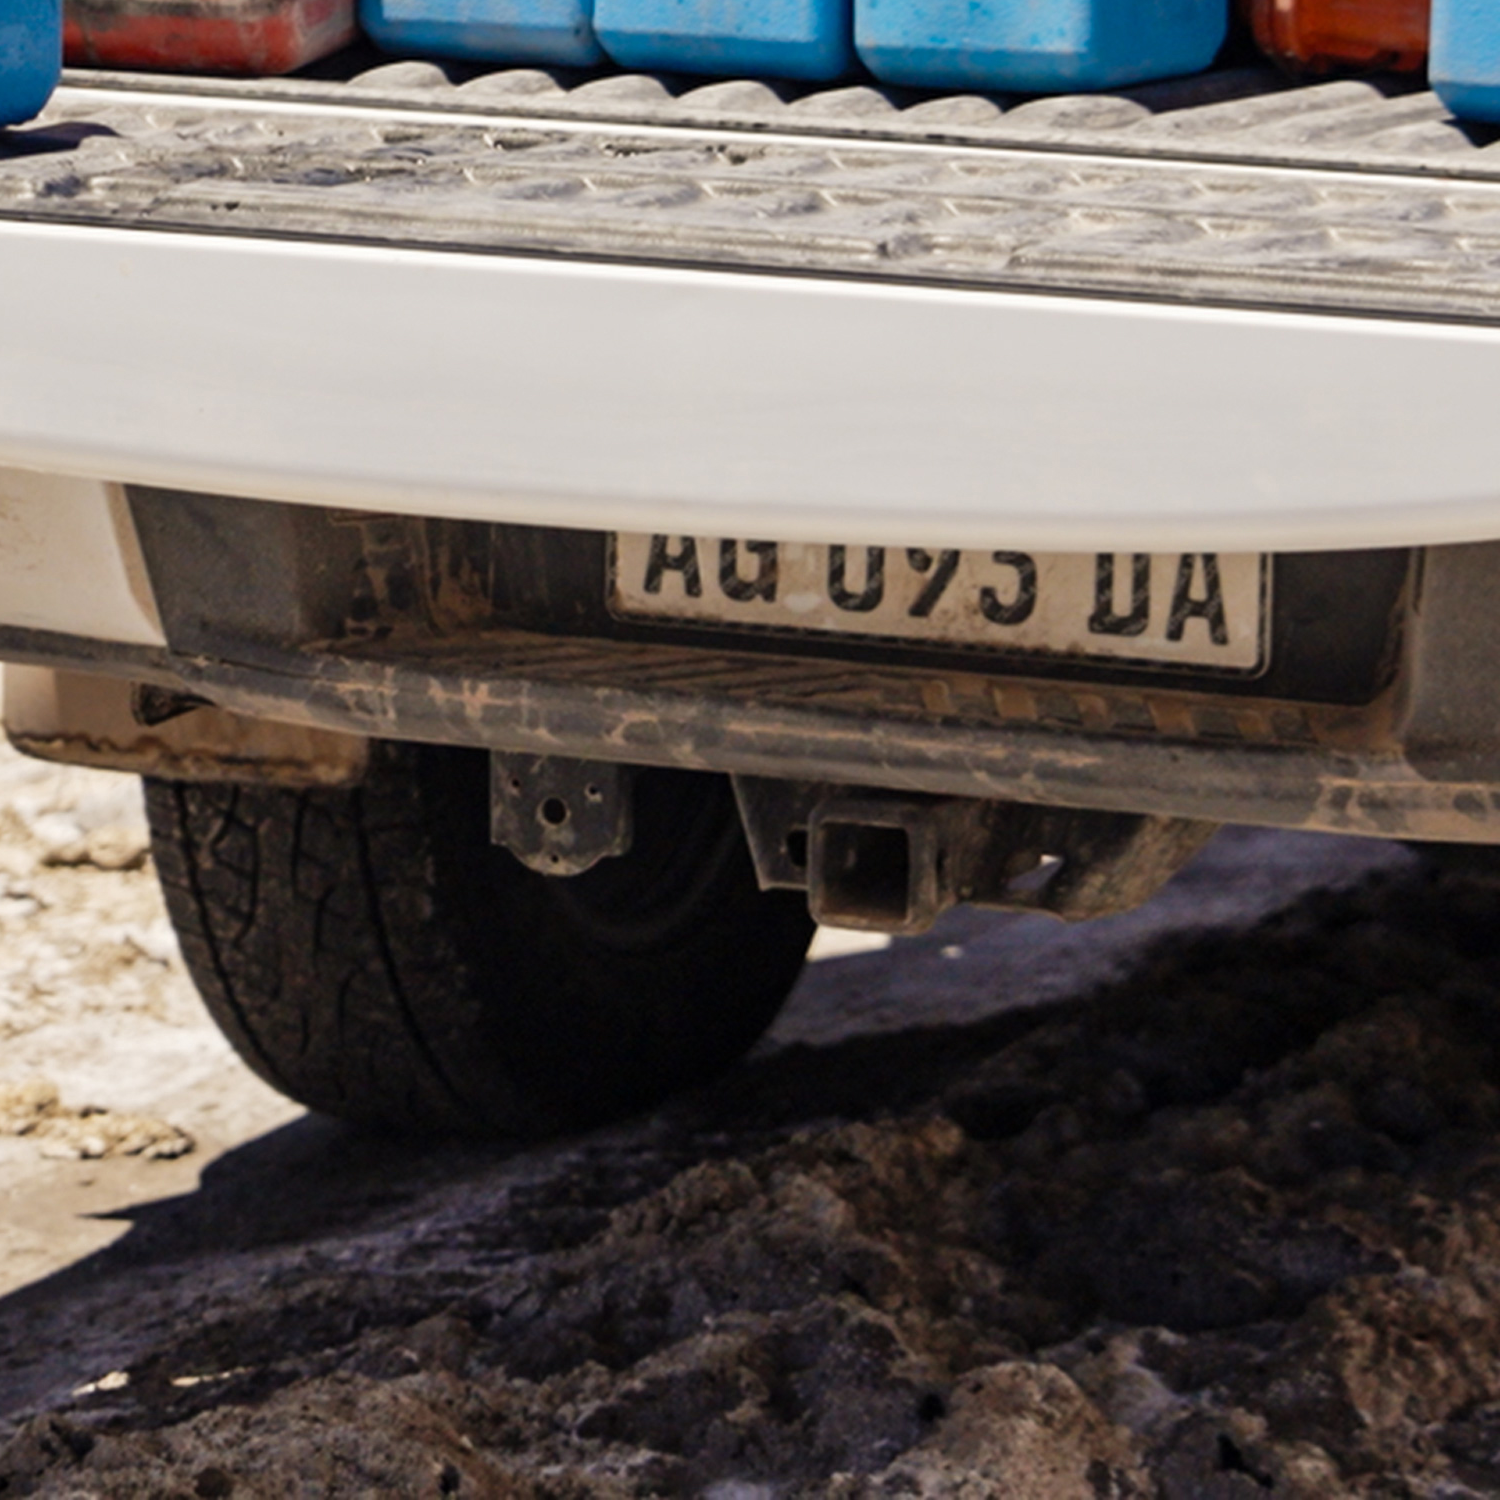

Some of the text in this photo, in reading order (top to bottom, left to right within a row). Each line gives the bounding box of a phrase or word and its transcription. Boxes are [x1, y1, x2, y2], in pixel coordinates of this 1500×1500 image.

[643, 533, 1229, 645] AG 093 DA
